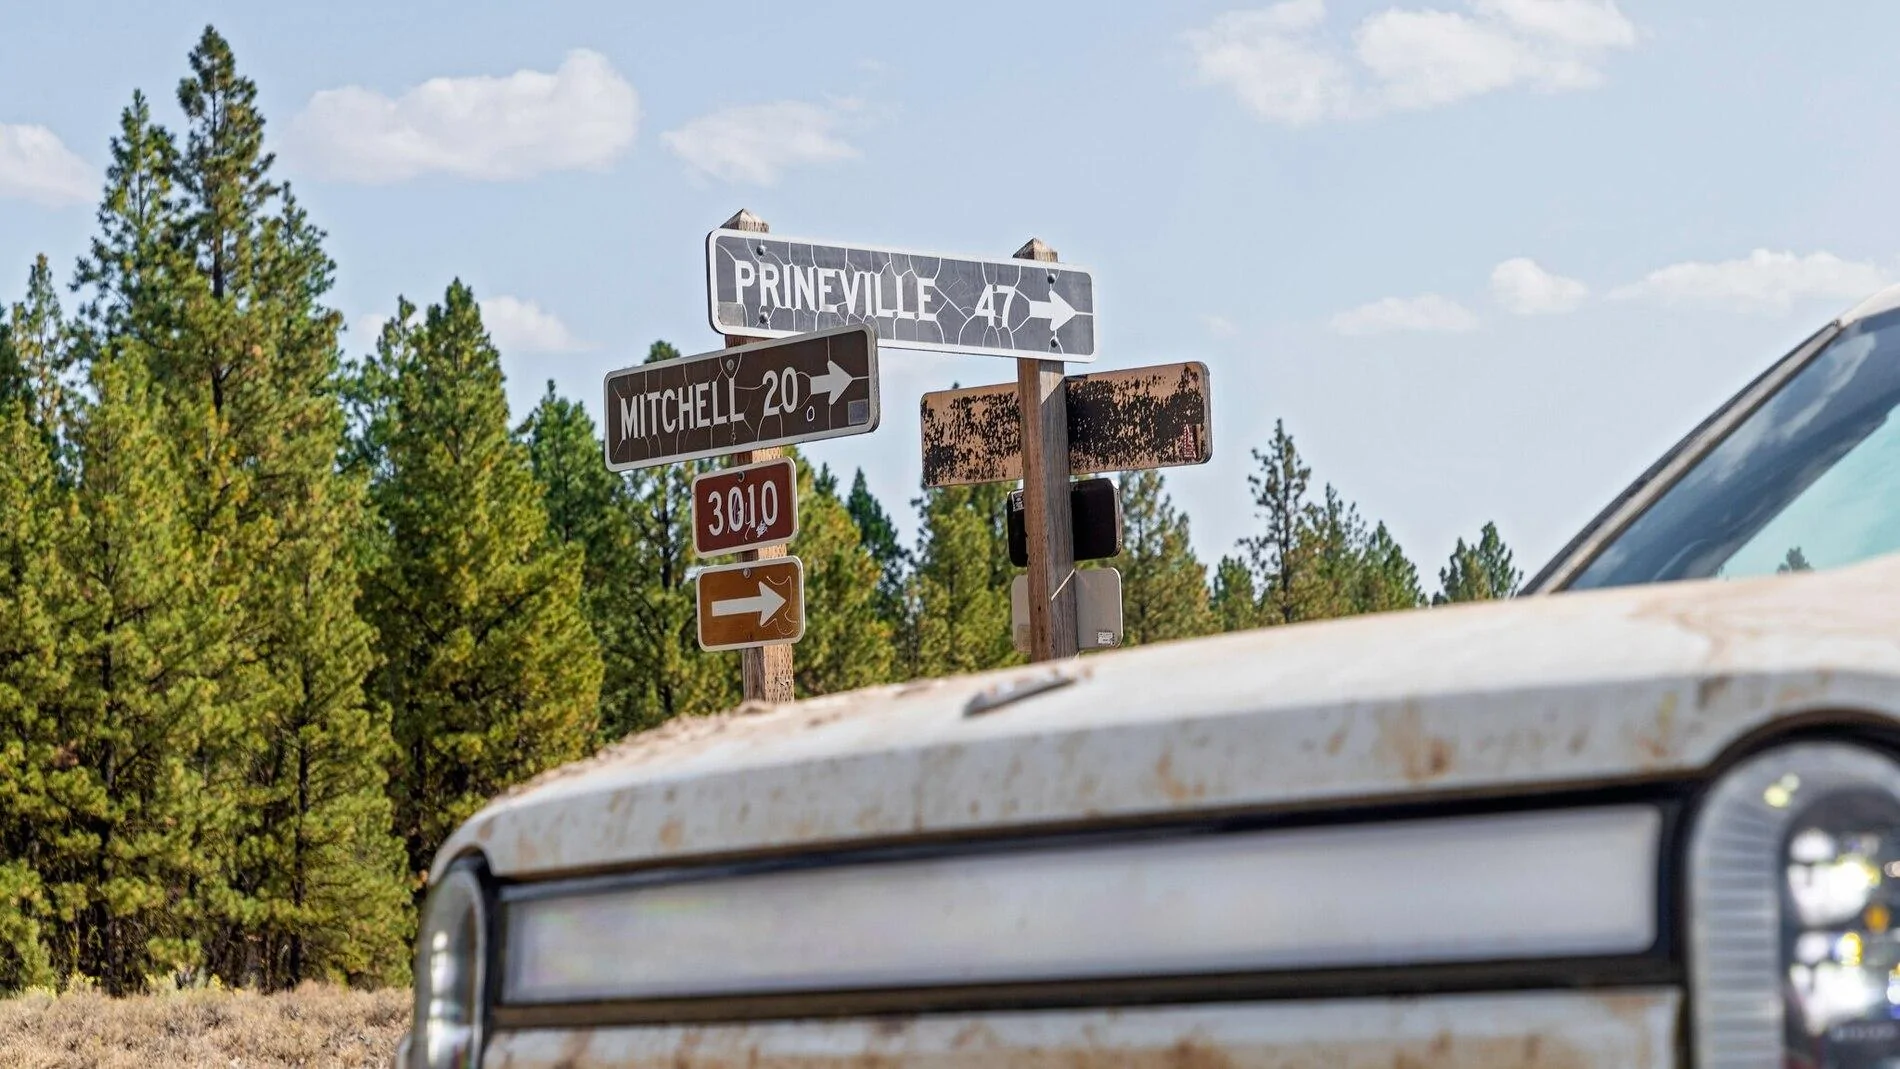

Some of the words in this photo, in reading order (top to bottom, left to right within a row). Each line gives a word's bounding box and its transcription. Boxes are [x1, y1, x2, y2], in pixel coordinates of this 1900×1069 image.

[735, 260, 936, 321] PRINEVILLE
[975, 285, 1015, 328] 47
[620, 378, 744, 440] MITCHELL
[763, 366, 798, 416] 20
[708, 480, 778, 536] 3010
